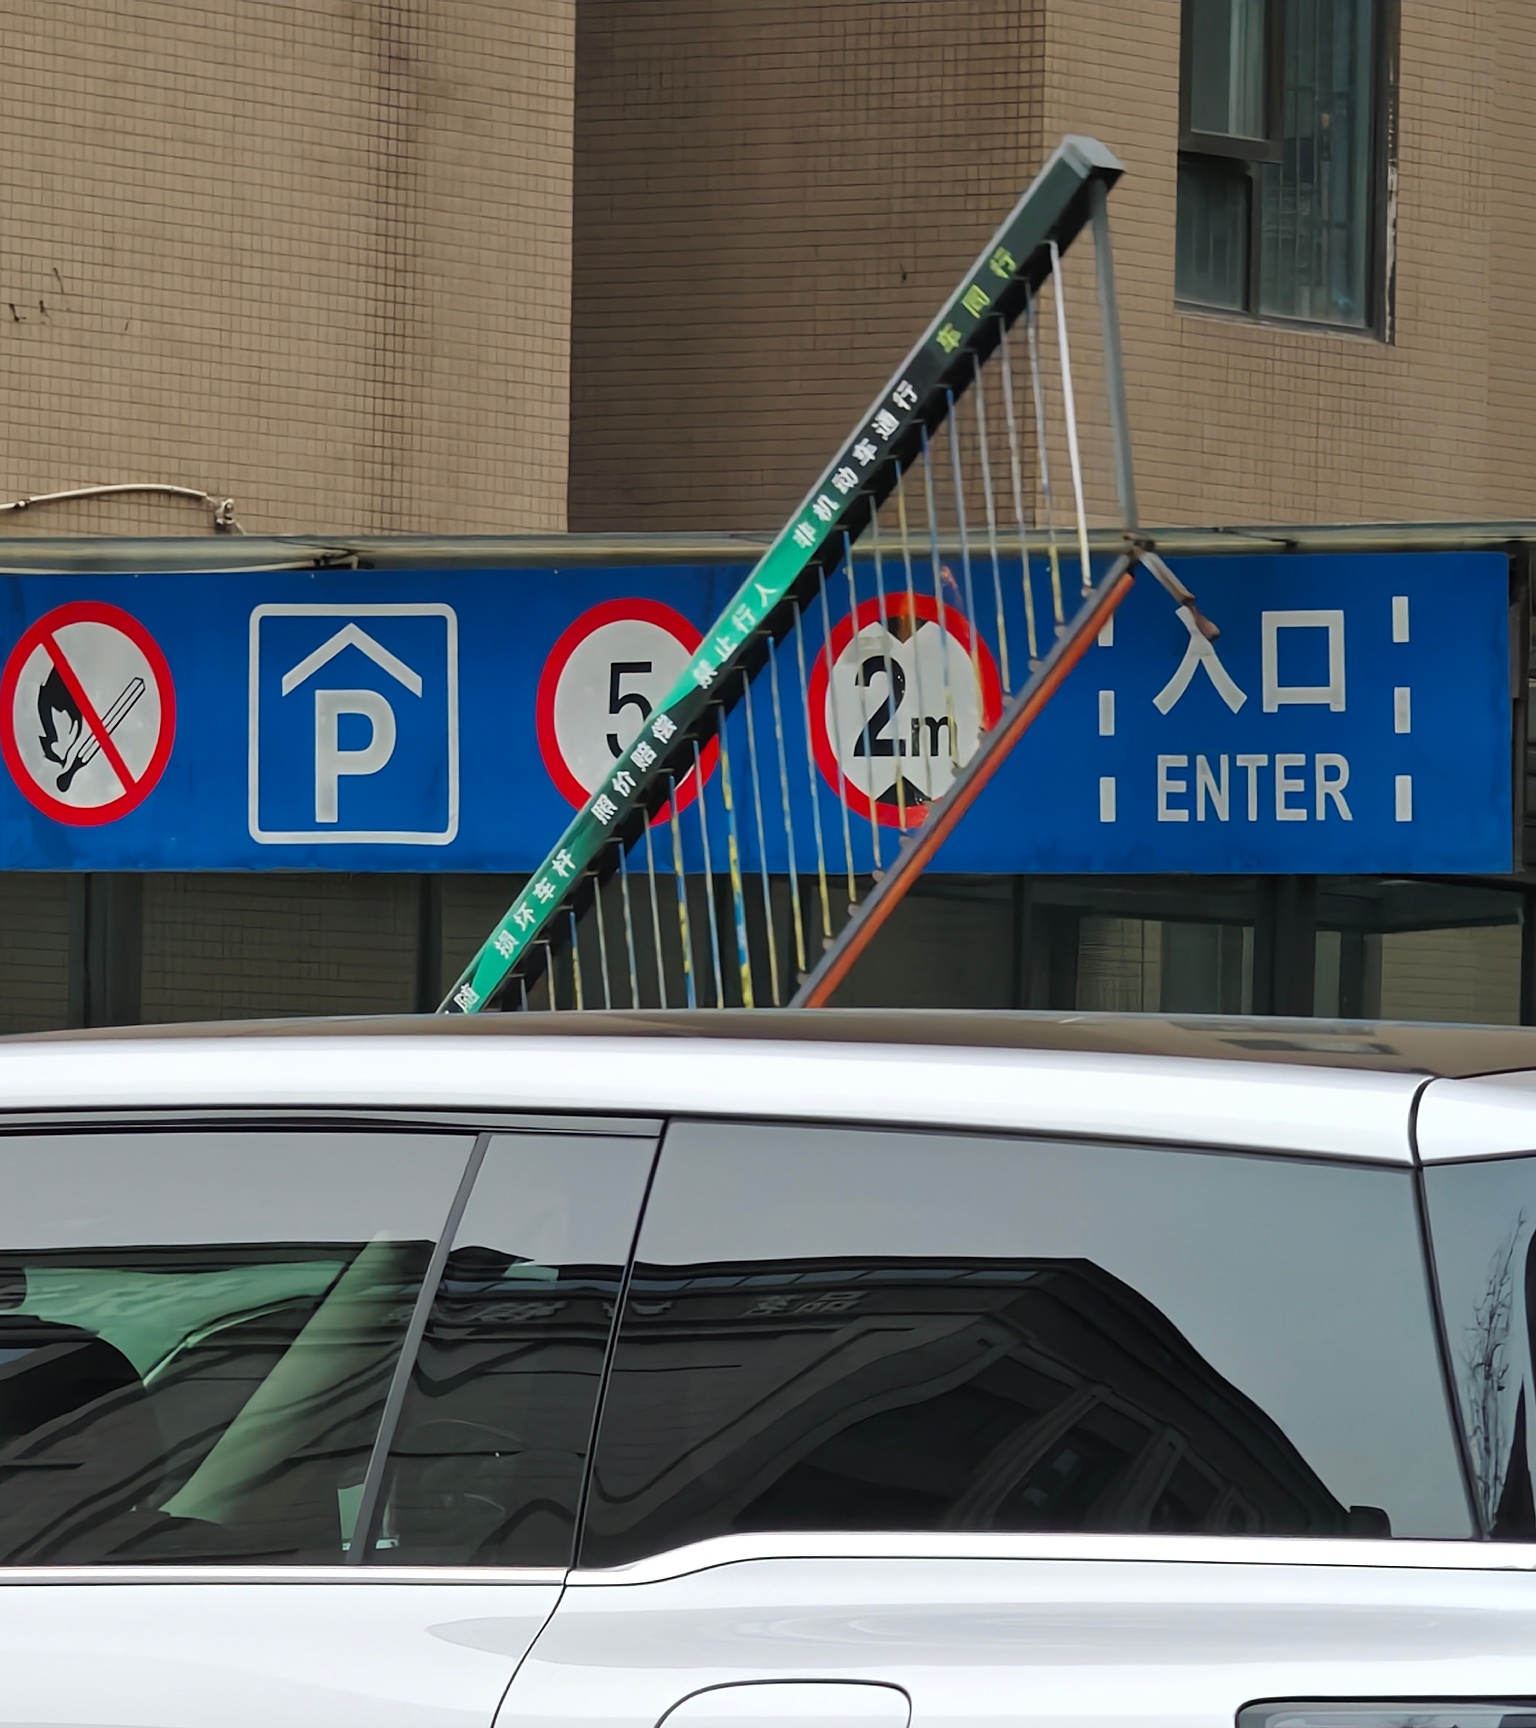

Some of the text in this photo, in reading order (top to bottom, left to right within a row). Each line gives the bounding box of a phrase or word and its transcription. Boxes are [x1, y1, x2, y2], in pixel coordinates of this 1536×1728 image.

[493, 849, 576, 959] 损坏车杆
[591, 714, 677, 825] 照价赔偿
[792, 380, 918, 548] 非机动车通行
[606, 661, 653, 759] 5
[853, 655, 958, 757] 2m
[1152, 605, 1346, 715] 入口
[315, 689, 397, 824] P
[1157, 753, 1353, 822] ENTER
